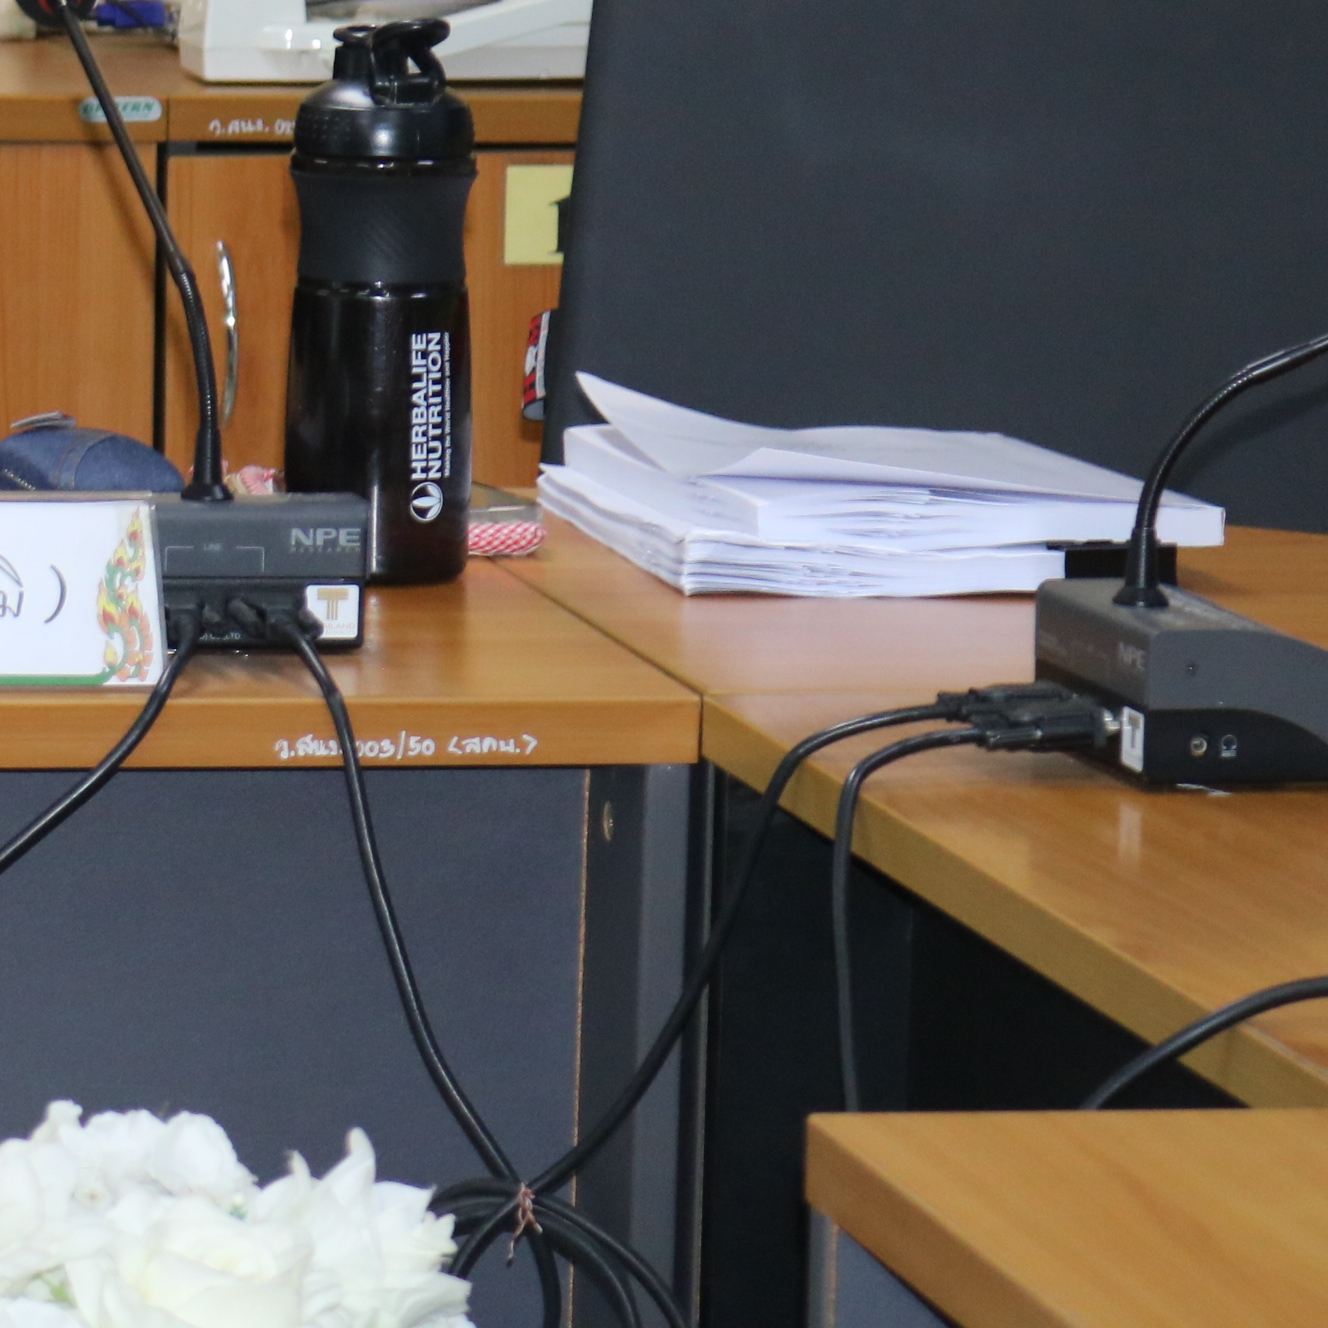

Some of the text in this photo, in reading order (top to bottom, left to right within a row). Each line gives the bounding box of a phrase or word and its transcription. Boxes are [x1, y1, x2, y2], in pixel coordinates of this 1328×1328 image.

[411, 333, 428, 480] HERBALIFE
[427, 332, 443, 480] NUTRITION
[290, 527, 362, 547] NPE
